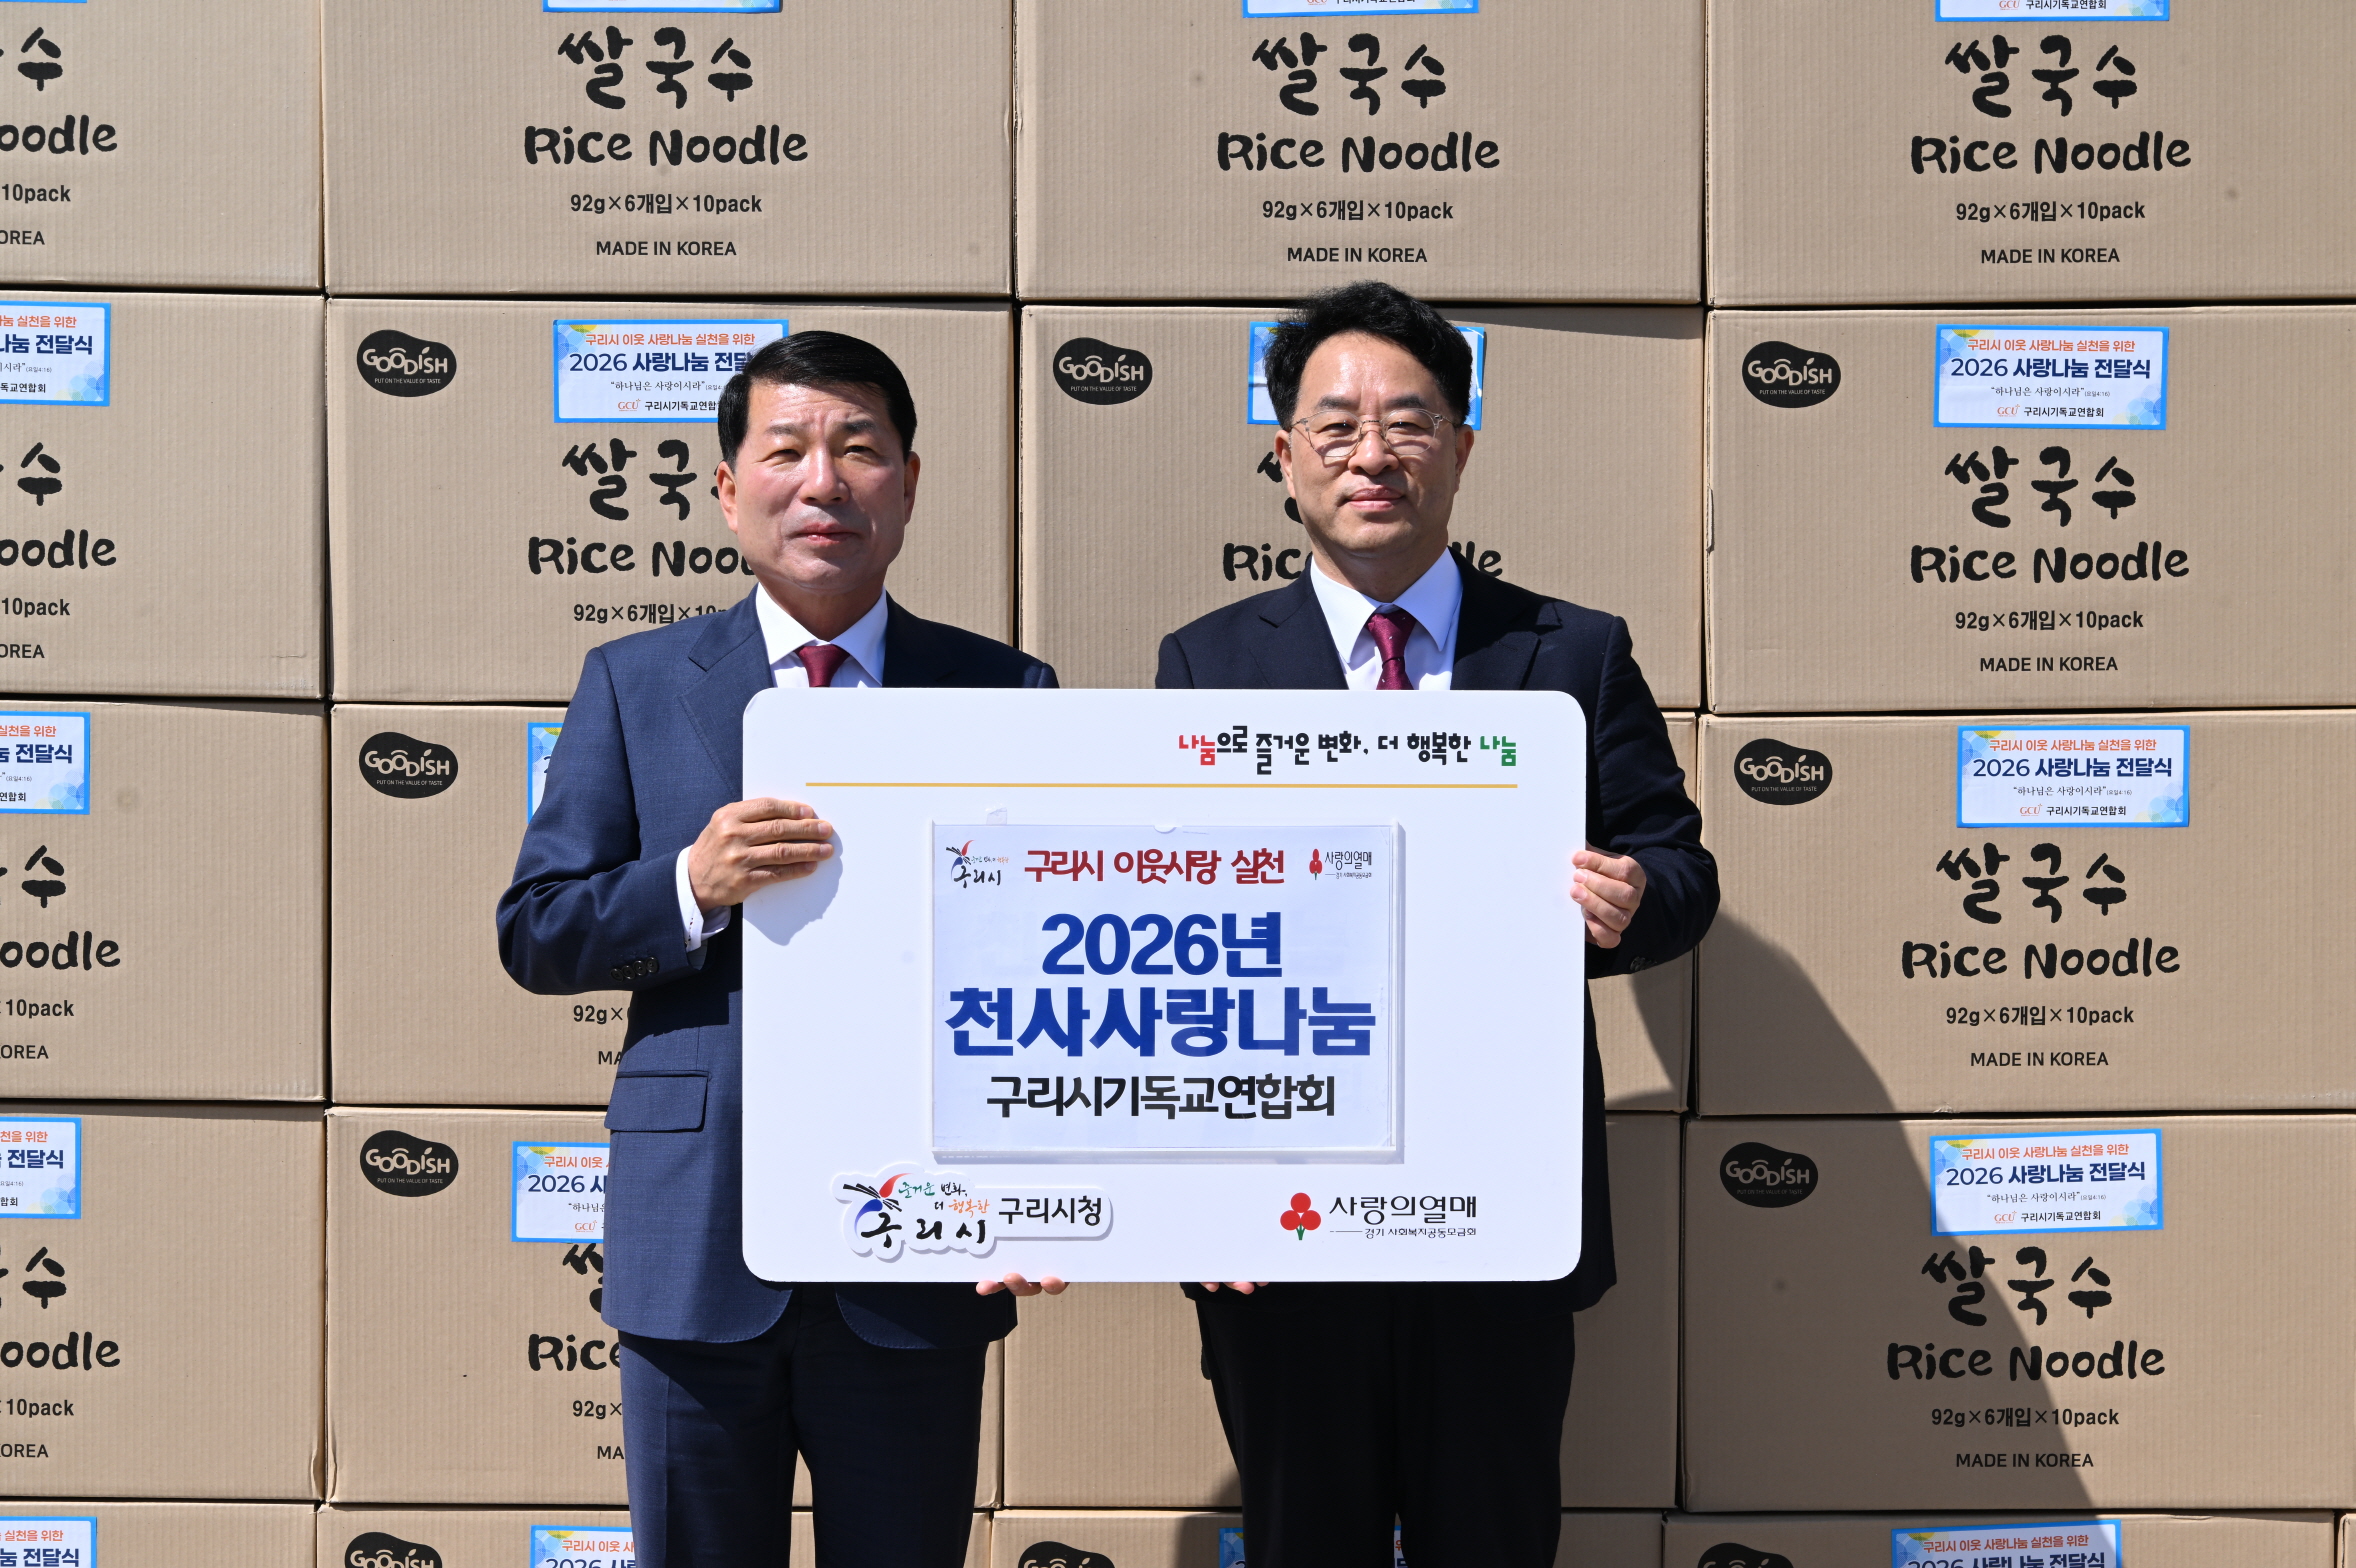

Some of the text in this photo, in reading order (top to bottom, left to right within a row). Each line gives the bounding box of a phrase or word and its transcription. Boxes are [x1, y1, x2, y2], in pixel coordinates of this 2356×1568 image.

[2026, 0, 2106, 9] 구리시기독교연합회
[558, 26, 753, 109] 쌀국수
[1252, 32, 1446, 116] 쌀국수
[1945, 35, 2137, 118] 쌀국수
[524, 124, 808, 166] Rice Noodle
[1217, 131, 1499, 173] Rice Noodle
[1911, 131, 2191, 174] Rice Noodle
[597, 241, 736, 255] MADE IN KOREA
[1288, 248, 1427, 262] MADE IN KOREA
[1982, 248, 2120, 263] MADE IN KOREA
[17, 316, 77, 328] 실천을 위한
[36, 335, 92, 355] 전달식
[586, 334, 755, 345] 구리시 이웃 사랑나눔 실천을 위한
[1968, 339, 2135, 352] 구리시 이웃 사랑나눔 실천을 위한
[363, 347, 447, 375] GOODISH
[570, 352, 752, 372] 2026 사랑나눔 전달
[1059, 355, 1143, 382] GOODISH
[1951, 358, 2150, 378] 2026 사랑나눔 전달식
[1748, 358, 1832, 386] GOODISH
[618, 401, 718, 411] GCU 구리시기독교연합
[1997, 407, 2103, 417] GCU 구리시기독교연합회
[562, 438, 718, 521] 쌀국
[1945, 446, 2136, 528] 쌀국수
[528, 537, 635, 575] Rice
[1222, 543, 1310, 581] Ric
[1911, 541, 2189, 583] Rice Noodle
[1981, 657, 2118, 671] MADE IN KOREA
[34, 726, 56, 737] 위한
[16, 744, 72, 763] 전달식
[1179, 726, 1516, 775] 나눔으로 즐거운 변화, 더 행복한 나눔
[1990, 739, 2156, 751] 구리시 이웃 사랑나눔 실천을 위한
[365, 749, 449, 776] GOODISH
[1740, 755, 1824, 783] GOODISH
[1974, 758, 2171, 777] 2026 사랑나눔 전달식
[2047, 806, 2126, 815] 구리시기독교연합회
[1025, 850, 1103, 882] 구리시
[1114, 849, 1221, 885] 이웃사랑
[1231, 848, 1284, 884] 실천
[1326, 851, 1371, 870] 사랑의열매
[1936, 843, 2127, 924] 쌀국수
[1042, 912, 1282, 977] 2026년
[1902, 937, 2180, 979] Rice Noodle
[945, 987, 1375, 1057] 천사사랑나눔
[1971, 1052, 2108, 1066] MADE IN KOREA
[987, 1073, 1334, 1119] 구리시기독교연합회
[25, 1131, 48, 1142] 위한
[8, 1150, 63, 1169] 전달식
[366, 1147, 450, 1175] GOODISH
[544, 1156, 602, 1168] 구리시 이웃
[1962, 1144, 2129, 1160] 구리시 이웃 사랑나눔 실천을 위한
[1726, 1159, 1809, 1186] GOODISH
[1946, 1162, 2145, 1185] 2026 사랑나눔 전달식
[528, 1175, 585, 1193] 2026
[899, 1182, 935, 1198] 즐거운
[935, 1199, 990, 1218] 더 행복한
[1330, 1196, 1476, 1225] 사랑의열매
[1994, 1211, 2100, 1223] GCU 구리시기독교연합회
[575, 1222, 595, 1230] GCU
[861, 1196, 1101, 1248] 구리시 구리시청
[1366, 1228, 1476, 1239] 경기 사회복지공동모금회
[1921, 1245, 2112, 1326] 쌀국수
[1887, 1340, 2165, 1382] Rice Noodle
[1957, 1453, 2094, 1468] MADE IN KOREA
[5, 1530, 63, 1541] 실천을 위한
[1923, 1535, 2089, 1553] 구리시 이웃 사랑나눔 실천을 위한
[24, 1549, 79, 1567] 전달식
